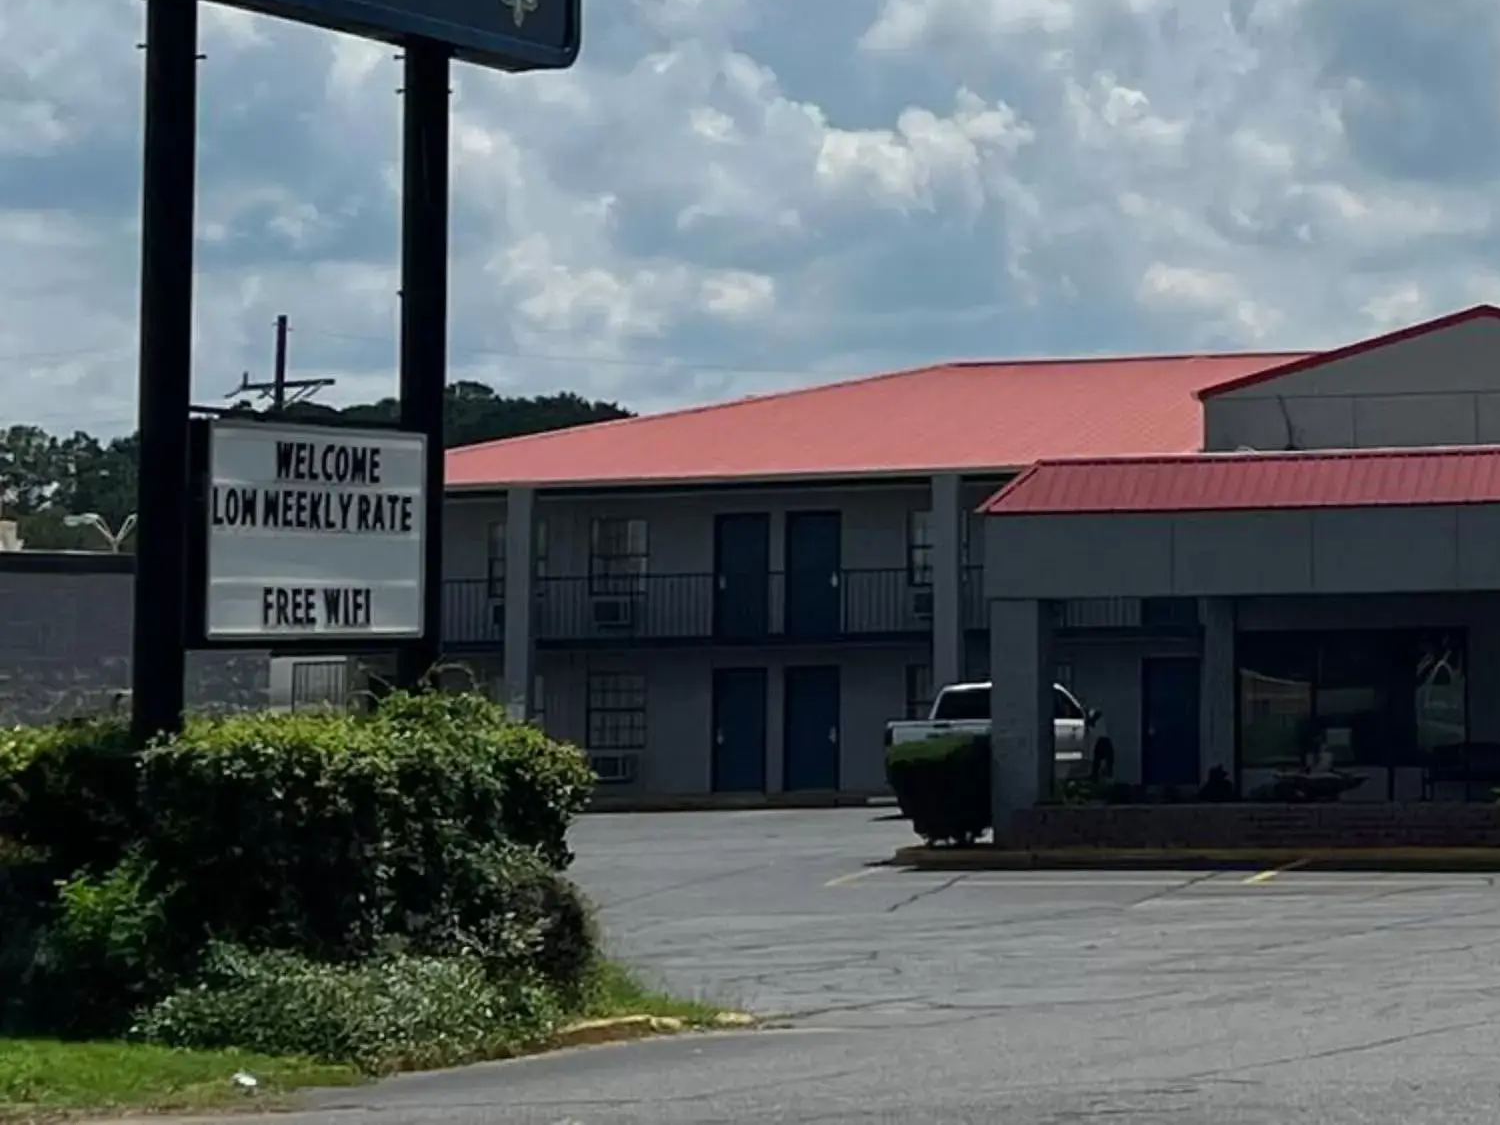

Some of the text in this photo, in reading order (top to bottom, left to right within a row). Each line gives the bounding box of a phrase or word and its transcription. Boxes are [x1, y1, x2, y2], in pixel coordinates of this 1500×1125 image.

[277, 442, 381, 484] WELCOME
[213, 487, 413, 532] LOW WEEKLY RATE
[263, 587, 371, 626] FREE WIFI
